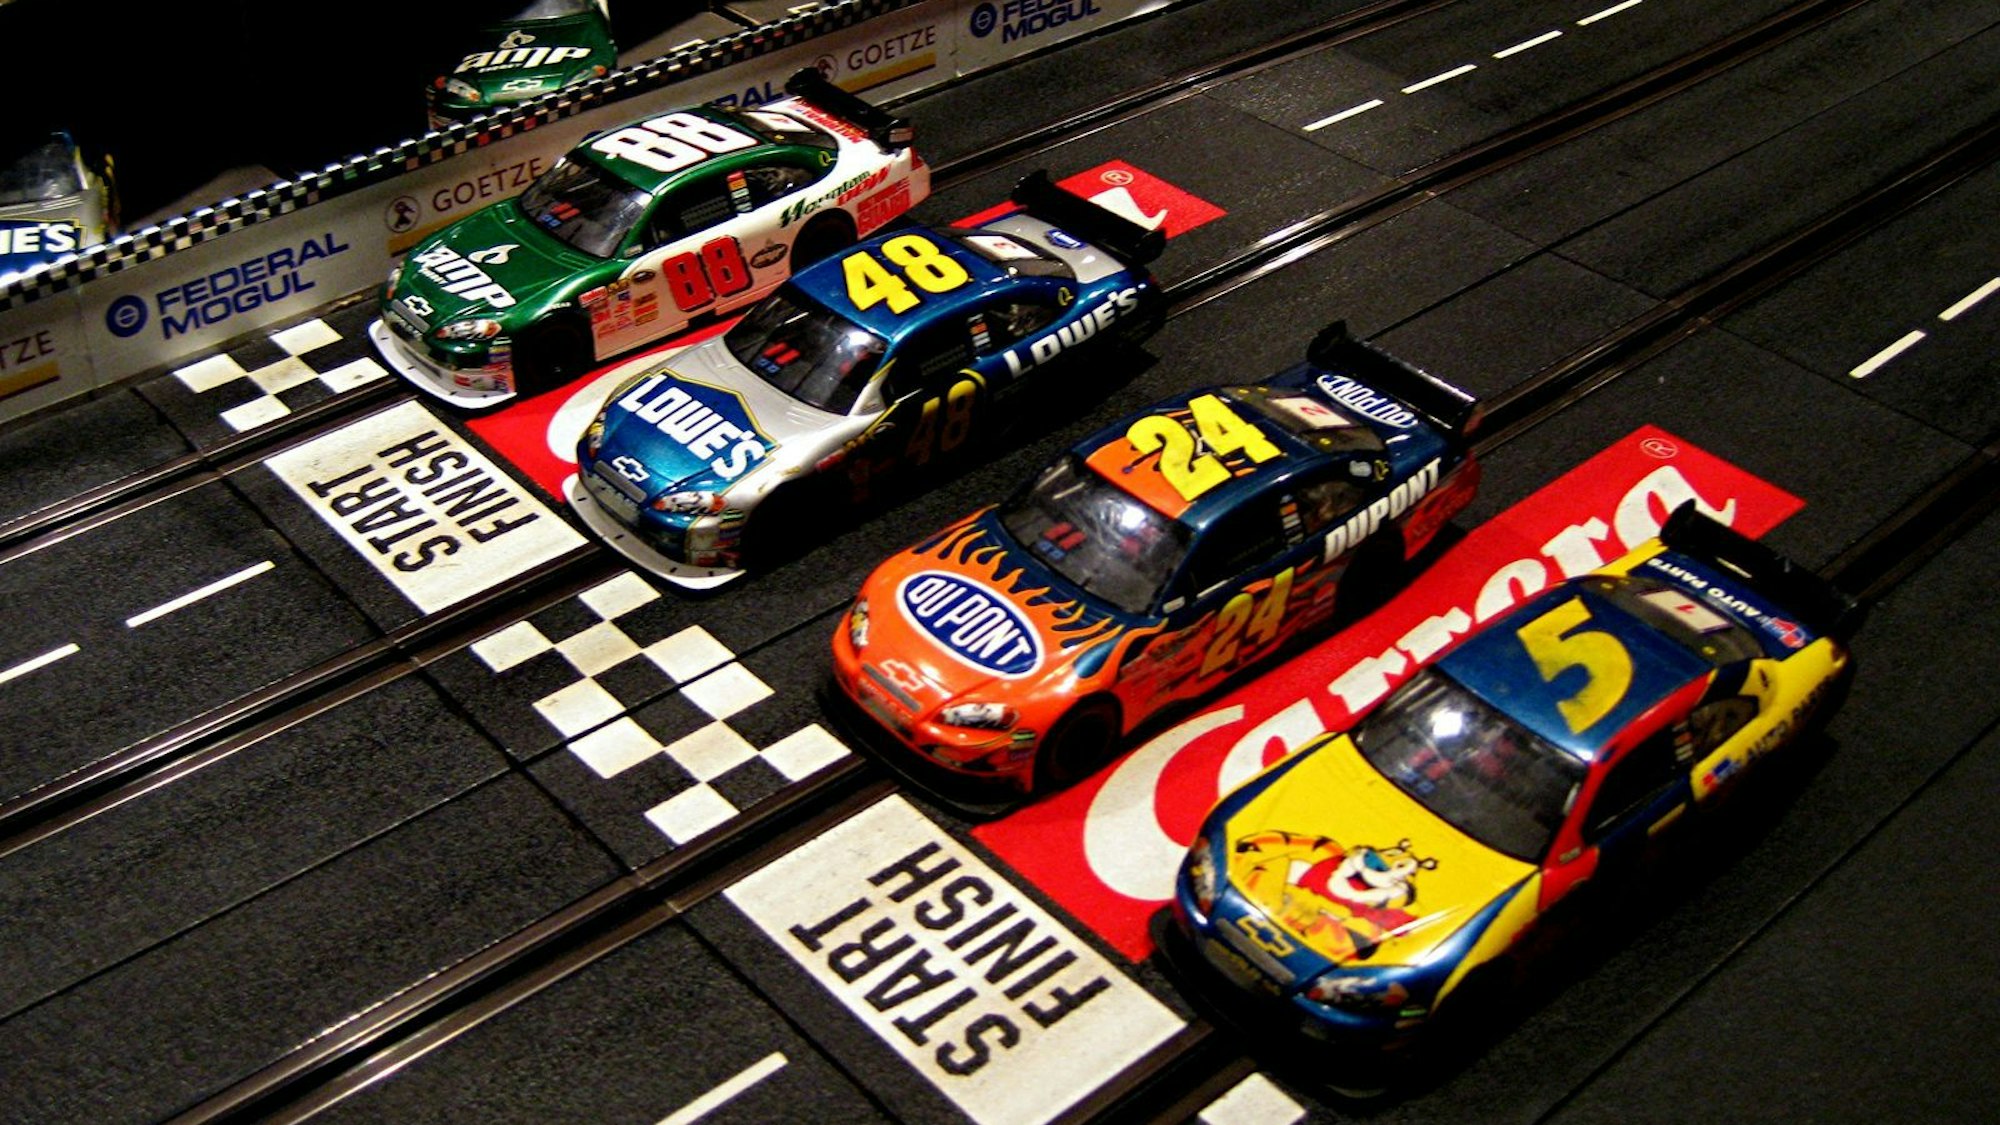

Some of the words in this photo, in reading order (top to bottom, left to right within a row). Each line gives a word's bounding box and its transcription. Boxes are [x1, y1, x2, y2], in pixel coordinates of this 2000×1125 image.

[847, 24, 937, 72] GOETZE
[433, 157, 543, 212] GOETZE
[591, 112, 759, 172] 88
[156, 232, 350, 316] FEDERAL
[161, 271, 316, 340] MOGUL
[662, 235, 753, 312] 88
[842, 234, 969, 315] 48
[1002, 286, 1139, 380] LOWE'S
[617, 373, 766, 479] LOWE'S
[1125, 393, 1282, 502] 24
[307, 463, 463, 572] START
[377, 429, 541, 545] FINISH
[1646, 557, 1709, 590] PARTS
[1708, 586, 1762, 618] AUTO
[1200, 566, 1295, 678] 24
[1516, 594, 1633, 736] 5
[866, 840, 1112, 1030] FINISH
[788, 896, 1022, 1077] START
